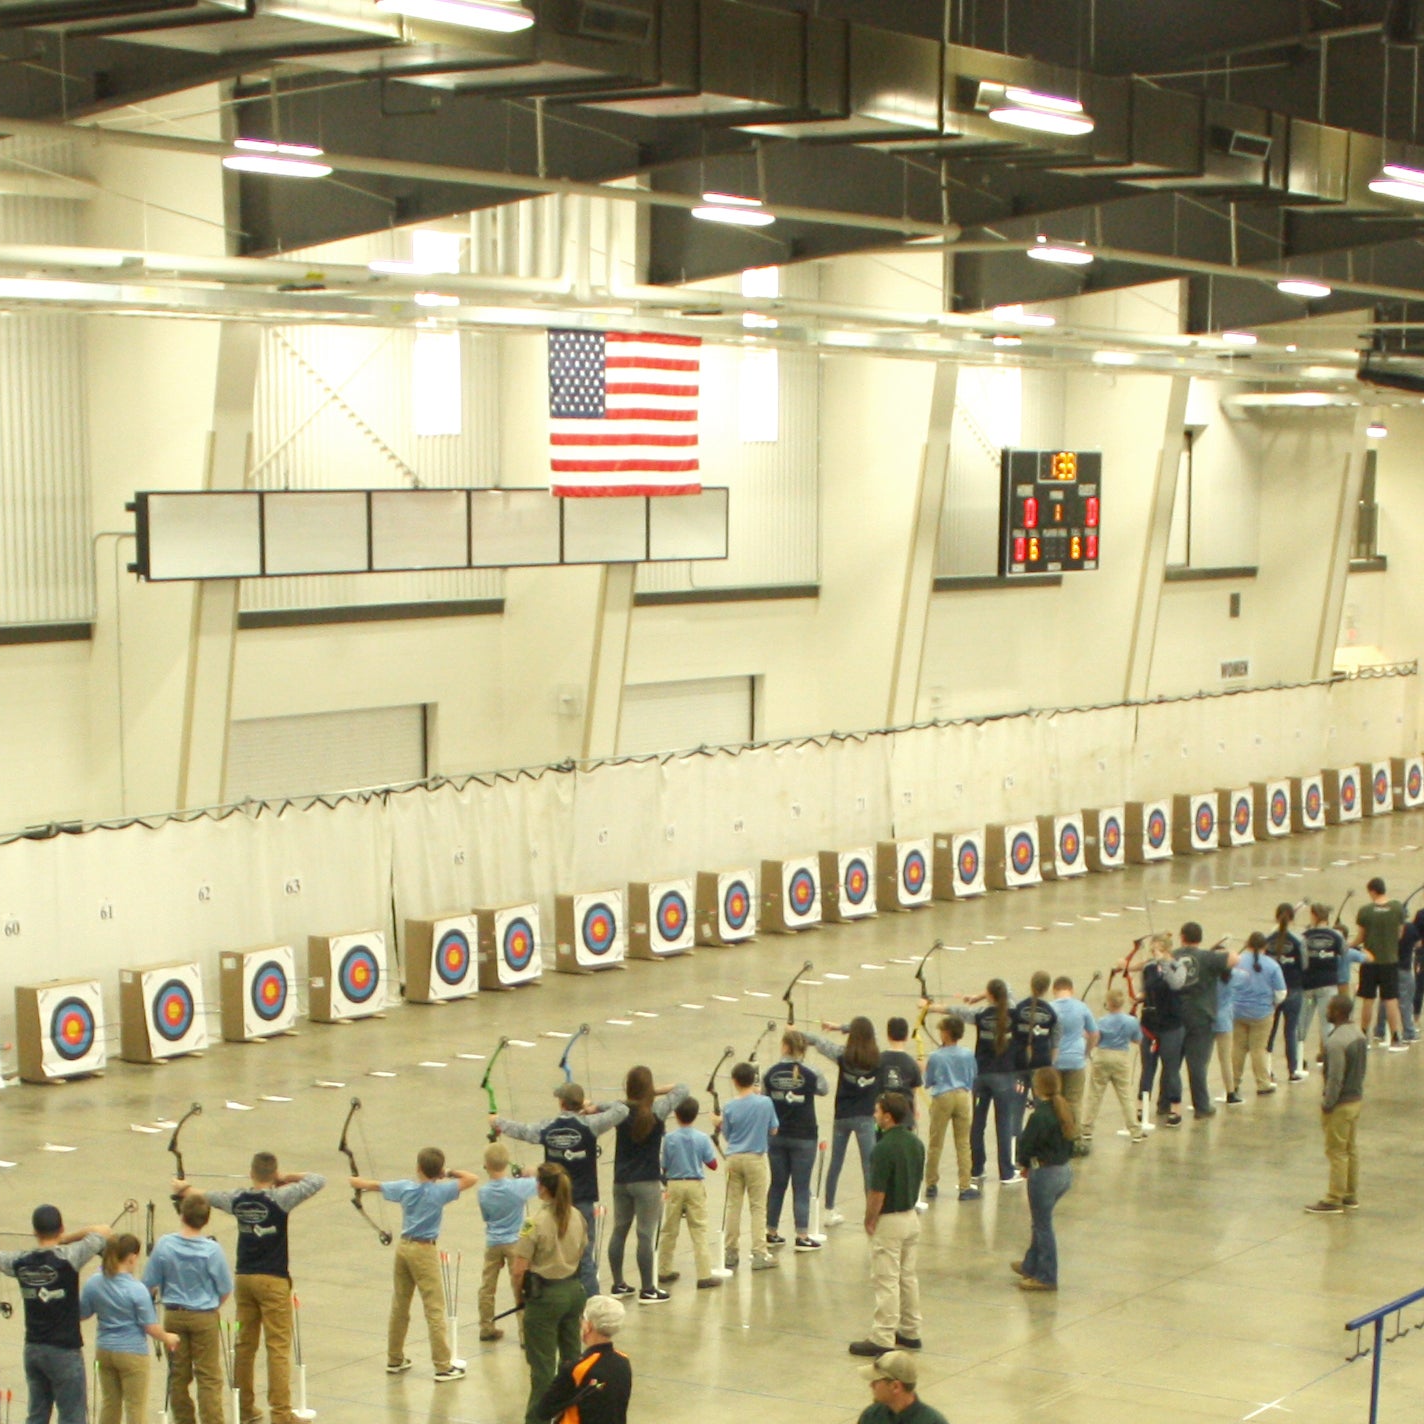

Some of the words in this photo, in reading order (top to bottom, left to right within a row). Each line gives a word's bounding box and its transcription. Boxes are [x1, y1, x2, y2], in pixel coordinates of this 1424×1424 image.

[198, 886, 211, 901] 62
[285, 879, 301, 895] 63
[100, 905, 113, 920] 61
[4, 921, 21, 937] 60
